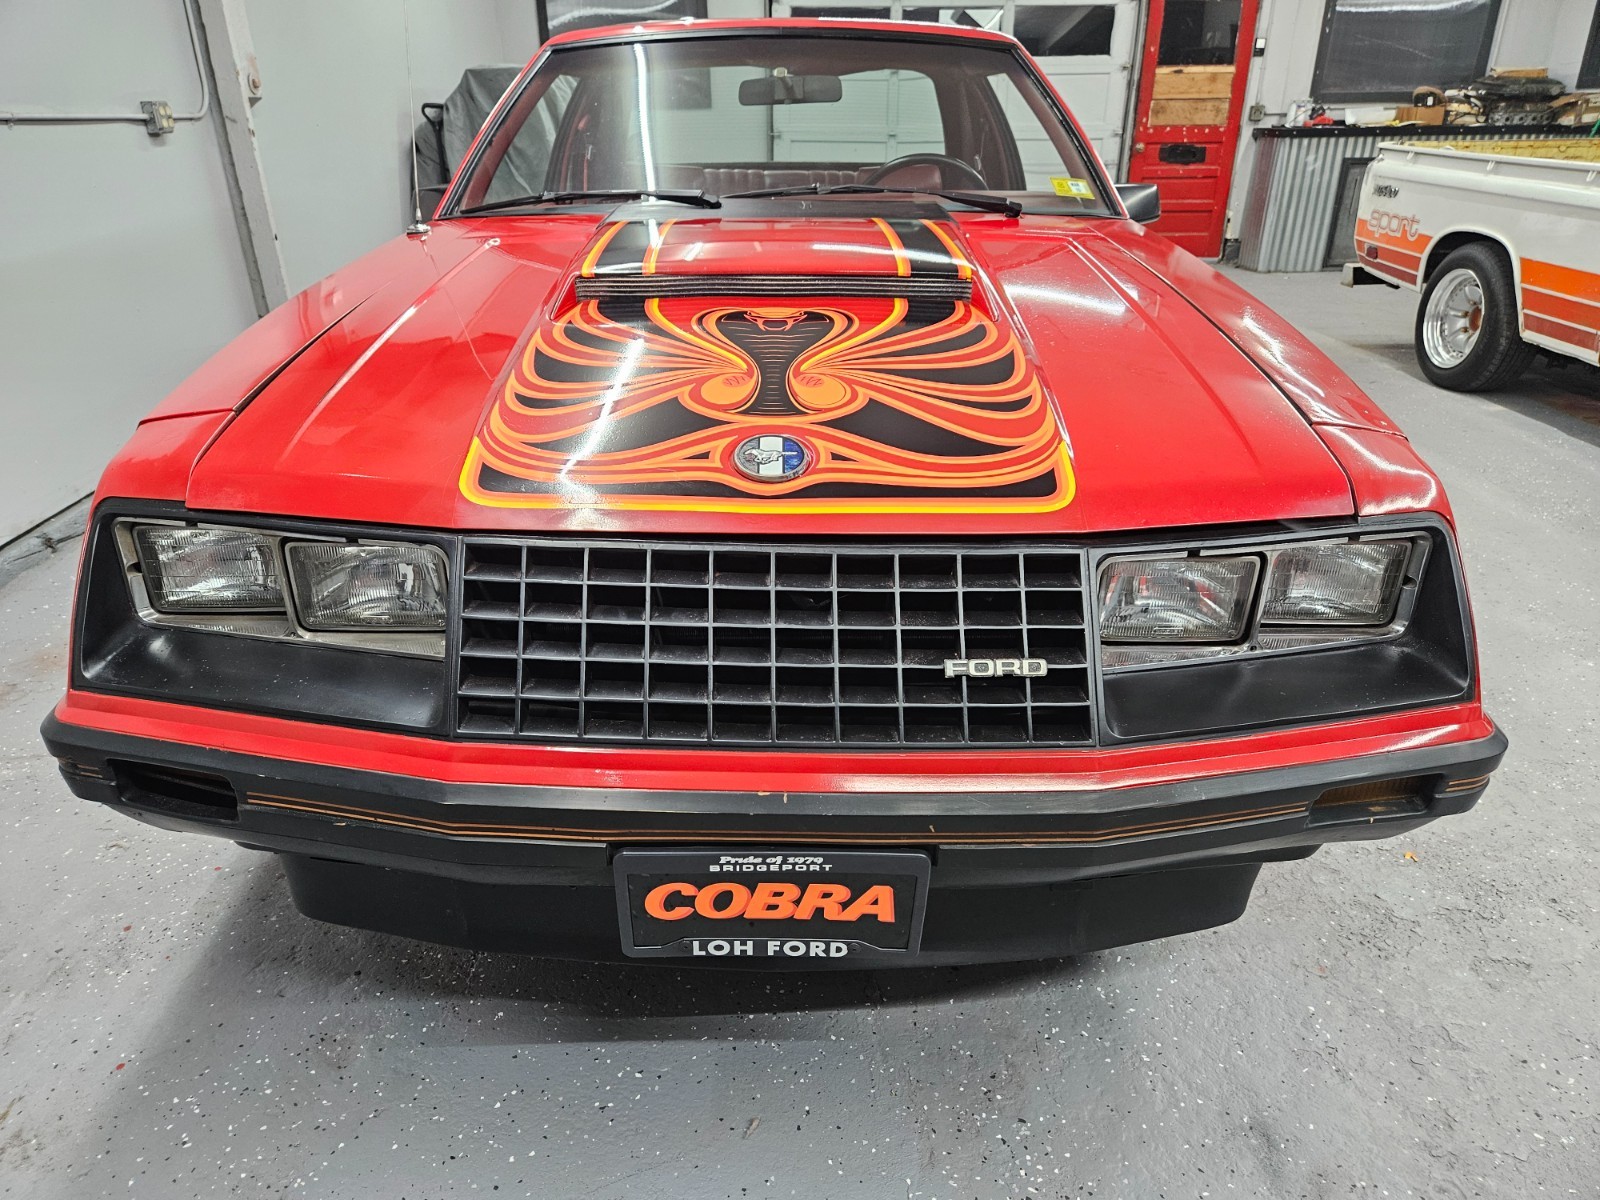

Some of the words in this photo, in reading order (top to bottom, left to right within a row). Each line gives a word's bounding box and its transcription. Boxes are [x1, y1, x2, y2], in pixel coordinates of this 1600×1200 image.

[1367, 208, 1421, 240] sport
[944, 658, 1048, 678] FORD
[709, 864, 833, 872] BRIDGEPORT
[719, 855, 763, 864] Pride
[765, 855, 783, 865] of
[786, 856, 824, 865] 1979
[644, 882, 896, 924] COBRA
[692, 940, 754, 956] LOH
[767, 940, 849, 958] FORD
